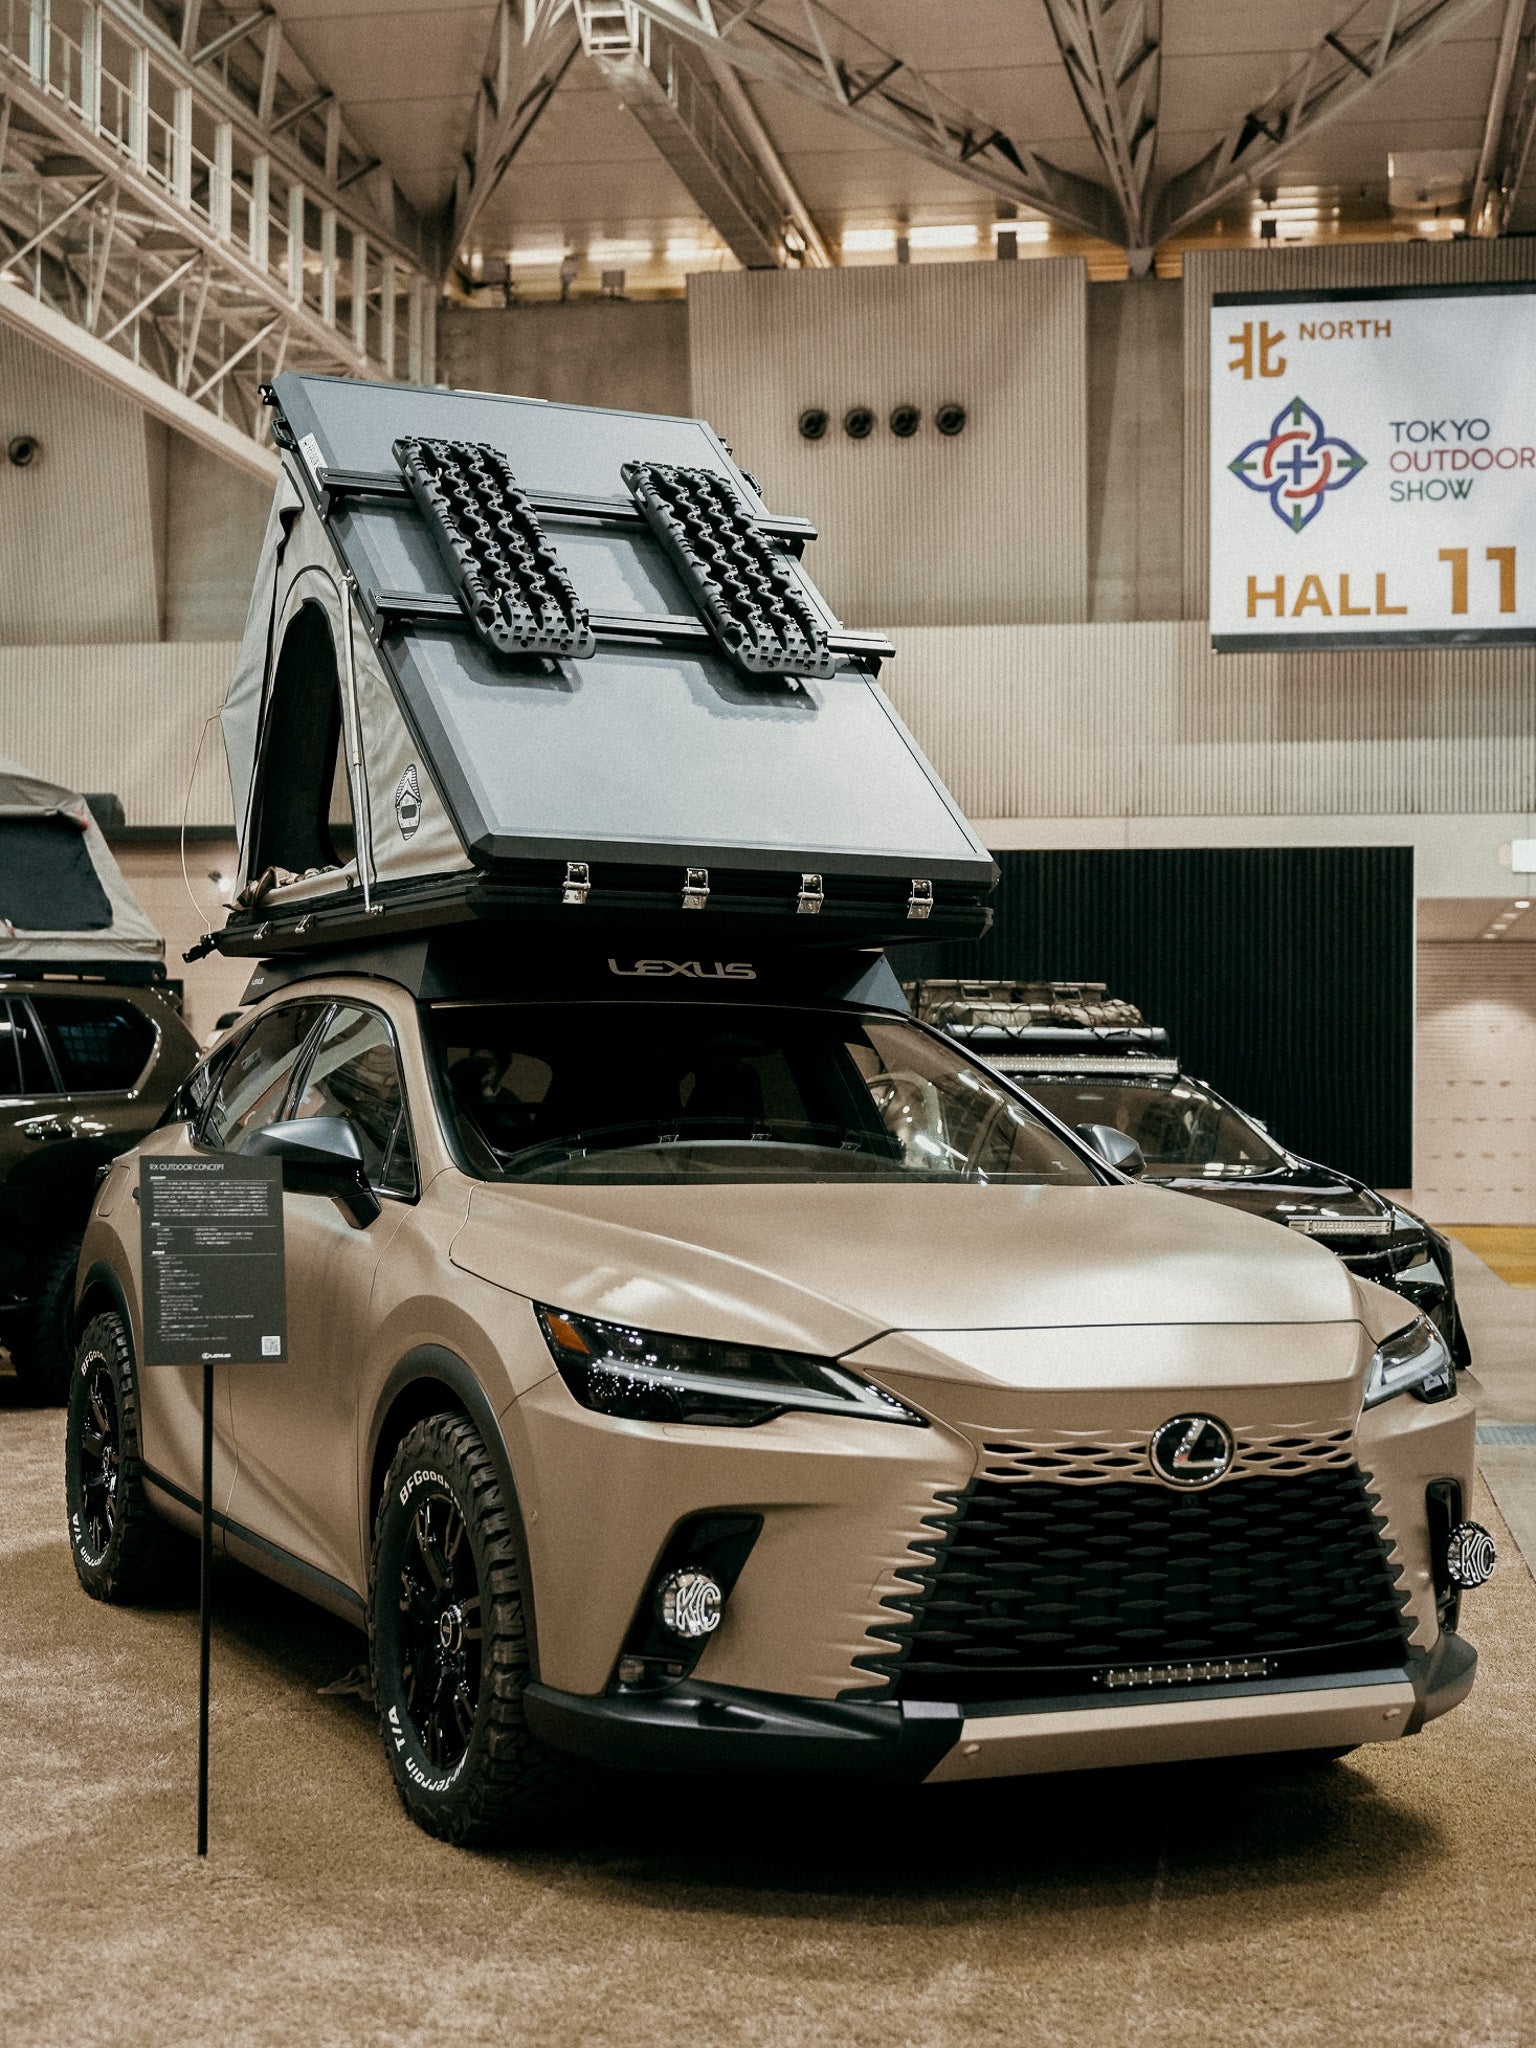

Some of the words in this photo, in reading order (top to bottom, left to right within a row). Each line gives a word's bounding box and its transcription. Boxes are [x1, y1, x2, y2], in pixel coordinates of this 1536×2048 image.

[1299, 319, 1391, 341] NORTH
[1229, 321, 1286, 380] 北
[1389, 418, 1490, 443] TOKYO
[1390, 448, 1535, 472] OUTDOOR
[1390, 479, 1474, 502] SHOW
[1247, 573, 1407, 618] HALL
[1438, 546, 1516, 615] 11
[607, 958, 757, 980] LEXUS
[159, 1163, 193, 1171] OUTDOOR
[193, 1163, 225, 1171] CONCEPT
[1461, 1533, 1496, 1583] KC
[676, 1579, 722, 1637] KC
[388, 1704, 406, 1753] T/A
